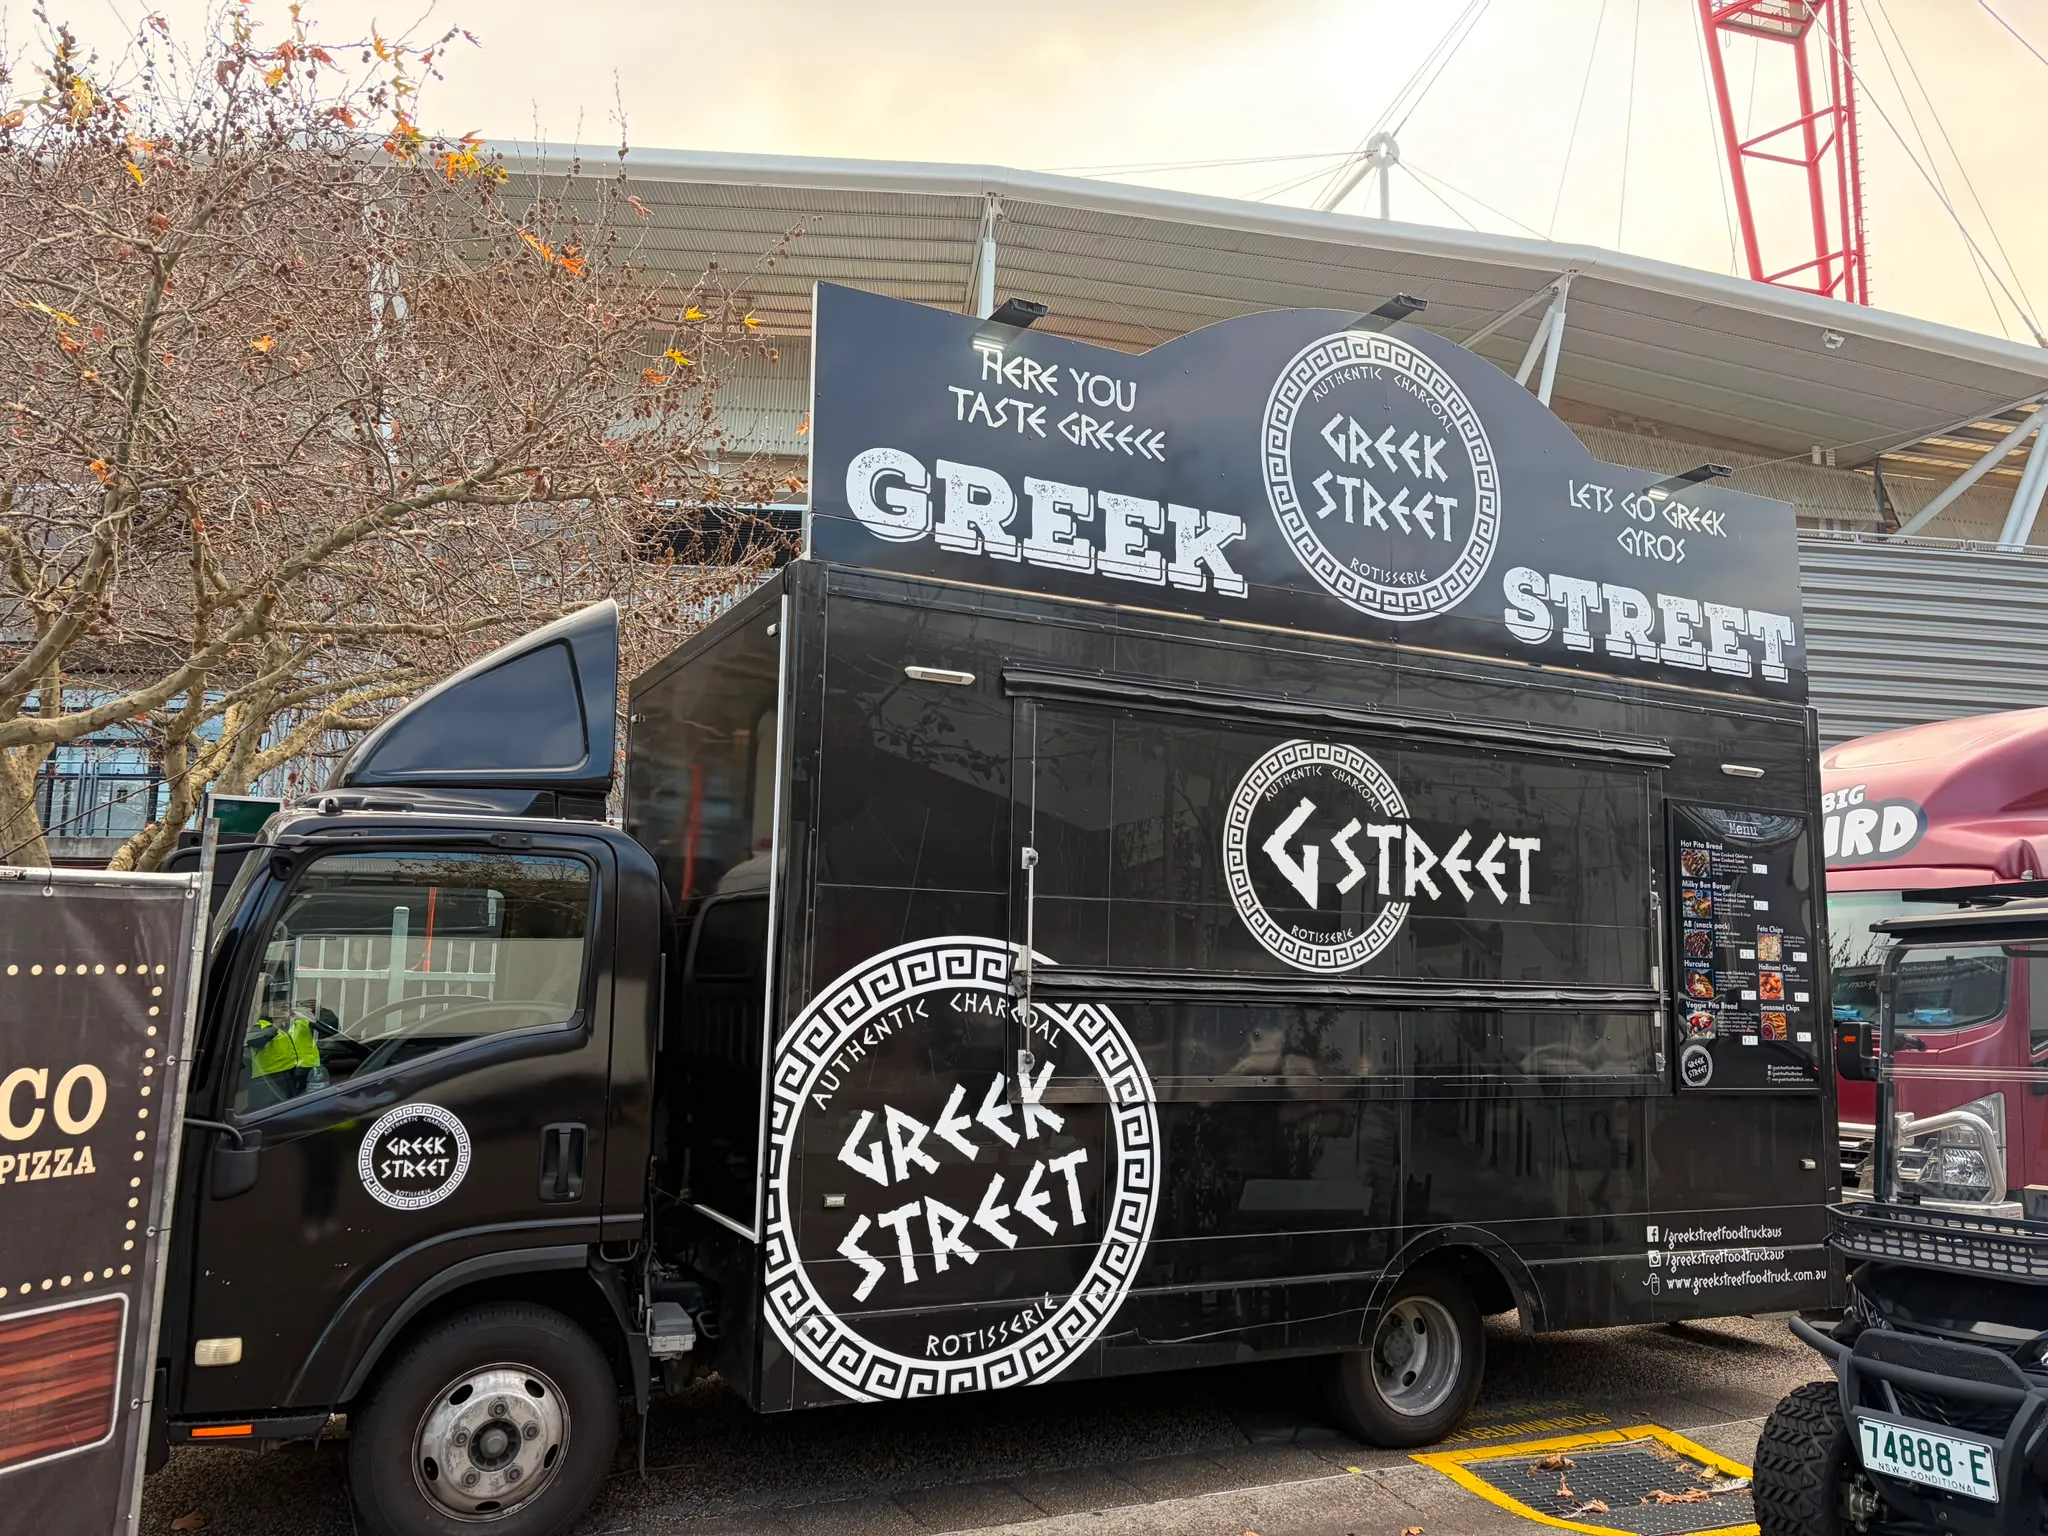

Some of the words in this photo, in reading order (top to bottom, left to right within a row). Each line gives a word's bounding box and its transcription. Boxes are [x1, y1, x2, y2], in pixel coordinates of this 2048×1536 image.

[982, 350, 1058, 397] HERE
[1069, 367, 1137, 413] YOU
[1311, 366, 1382, 402] AUTHENTIC
[1394, 374, 1452, 434] CHARCOAL
[948, 385, 1047, 438] TASTE
[1057, 411, 1166, 462] GREECE
[1320, 413, 1448, 483] GREEK
[1312, 470, 1458, 542] STREET
[1568, 479, 1614, 513] LETS
[1620, 492, 1656, 522] GO
[1662, 500, 1727, 538] GREEK
[846, 447, 1248, 599] GREEK
[1617, 526, 1686, 564] GYROS
[1350, 557, 1428, 585] ROTISSERIE
[1503, 566, 1796, 683] STREET
[1264, 765, 1323, 803] AUTHENTIC
[1331, 769, 1381, 813] CHARCOAL
[1822, 784, 1866, 814] BIG
[1728, 822, 1758, 836] Menu
[1824, 806, 1918, 858] IRD
[1262, 796, 1319, 910] G
[1330, 817, 1541, 905] STREET
[1680, 840, 1692, 848] Hot
[1693, 840, 1705, 849] Pita
[1706, 842, 1722, 850] Bread
[1682, 880, 1698, 889] Milky
[1712, 882, 1731, 891] Burger
[1291, 924, 1354, 943] ROTISSERIE
[1684, 920, 1692, 928] AB
[1694, 920, 1712, 929] (snack
[1714, 922, 1730, 931] pack)
[1757, 924, 1768, 932] Feta
[1769, 926, 1783, 934] Chips
[1759, 963, 1781, 971] Halloumi
[1782, 964, 1796, 973] Chips
[1685, 1001, 1706, 1010] Veggie
[1721, 1002, 1738, 1010] Bread
[1760, 1003, 1784, 1011] Seasoned
[1785, 1004, 1800, 1013] Chips
[812, 998, 930, 1111] AUTHENTIC
[949, 992, 1059, 1049] CHARCOAL
[1687, 1057, 1705, 1068] GREEK
[1688, 1065, 1707, 1078] STREET
[384, 1116, 418, 1136] AUTHENTIC
[423, 1116, 451, 1135] CHARCOAL
[837, 1060, 1065, 1188] GREEK
[386, 1136, 447, 1156] GREEK
[0, 1146, 96, 1184] PIZZA
[380, 1158, 449, 1179] STREET
[395, 1187, 431, 1198] ROTISSERIE
[837, 1147, 1088, 1302] STREET
[1663, 1225, 1782, 1250] /greekstreetfoodtruckaus
[1666, 1268, 1827, 1295] www.greekstreetfoodtruck.com.au
[926, 1291, 1058, 1357] ROTISSERIE
[1864, 1425, 1953, 1477] 74888
[1968, 1449, 1990, 1487] E
[1878, 1462, 1900, 1475] NSW
[1911, 1468, 1979, 1495] CONDITIONAL
